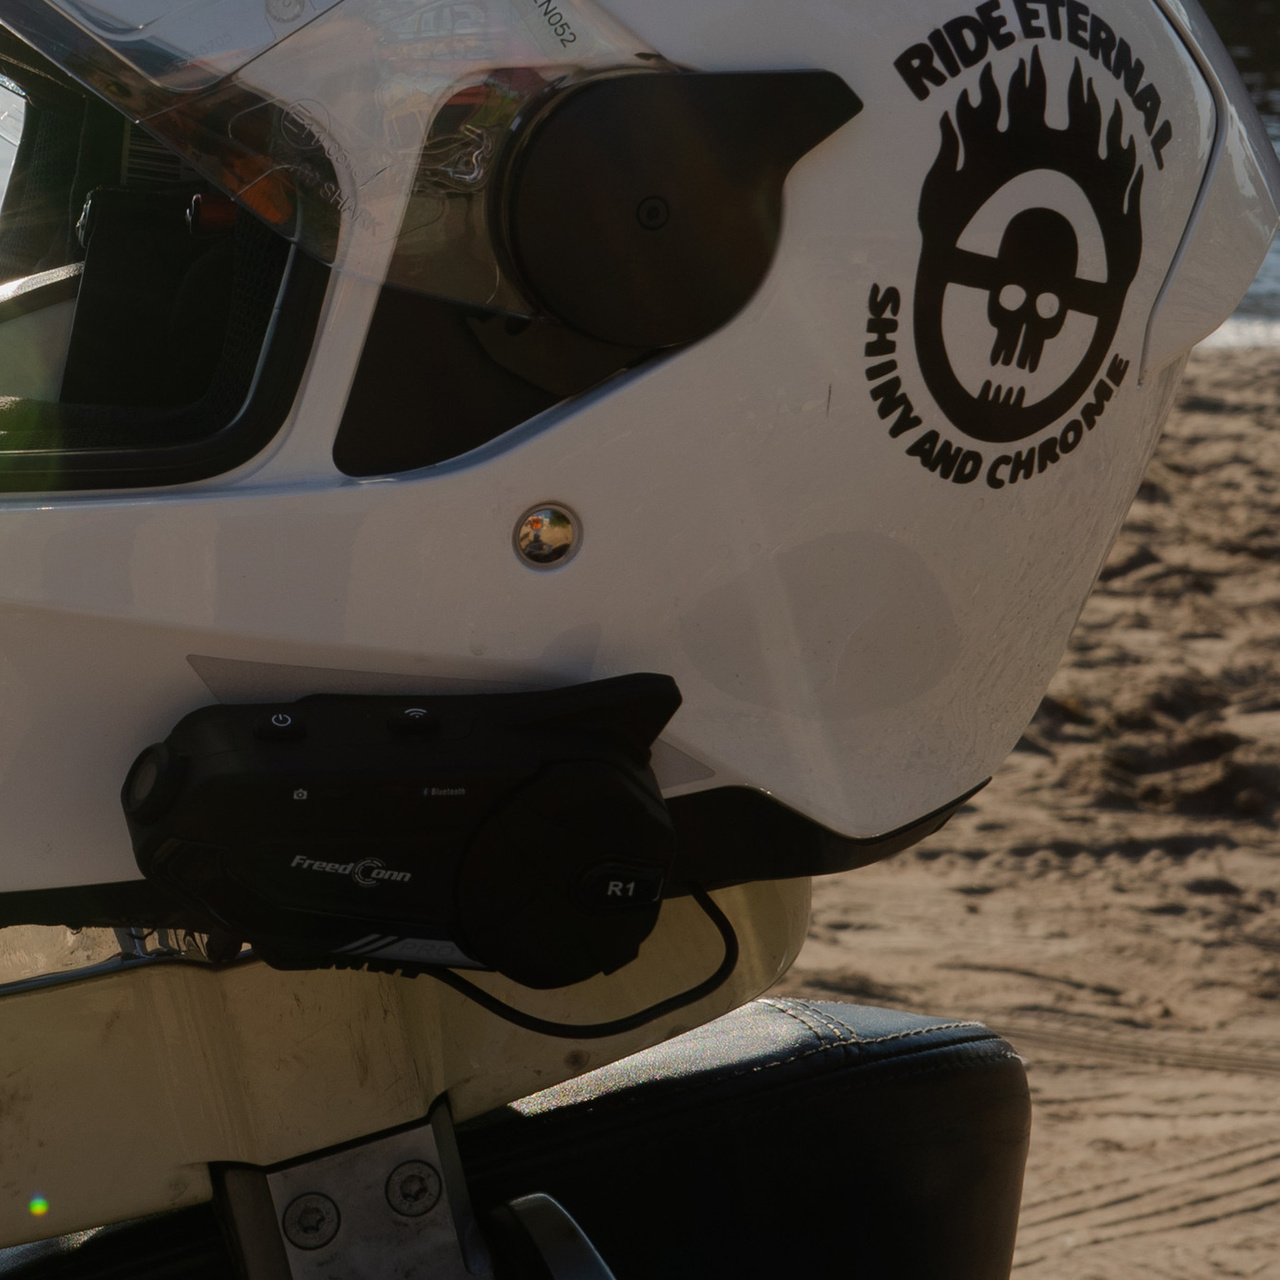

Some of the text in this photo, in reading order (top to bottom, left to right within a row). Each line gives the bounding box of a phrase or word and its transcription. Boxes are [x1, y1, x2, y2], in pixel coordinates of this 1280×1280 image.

[864, 282, 1130, 489] SHINY AND CHROME
[431, 787, 466, 796] Bluetooth
[290, 854, 412, 888] FreedConn
[607, 880, 636, 896] R1
